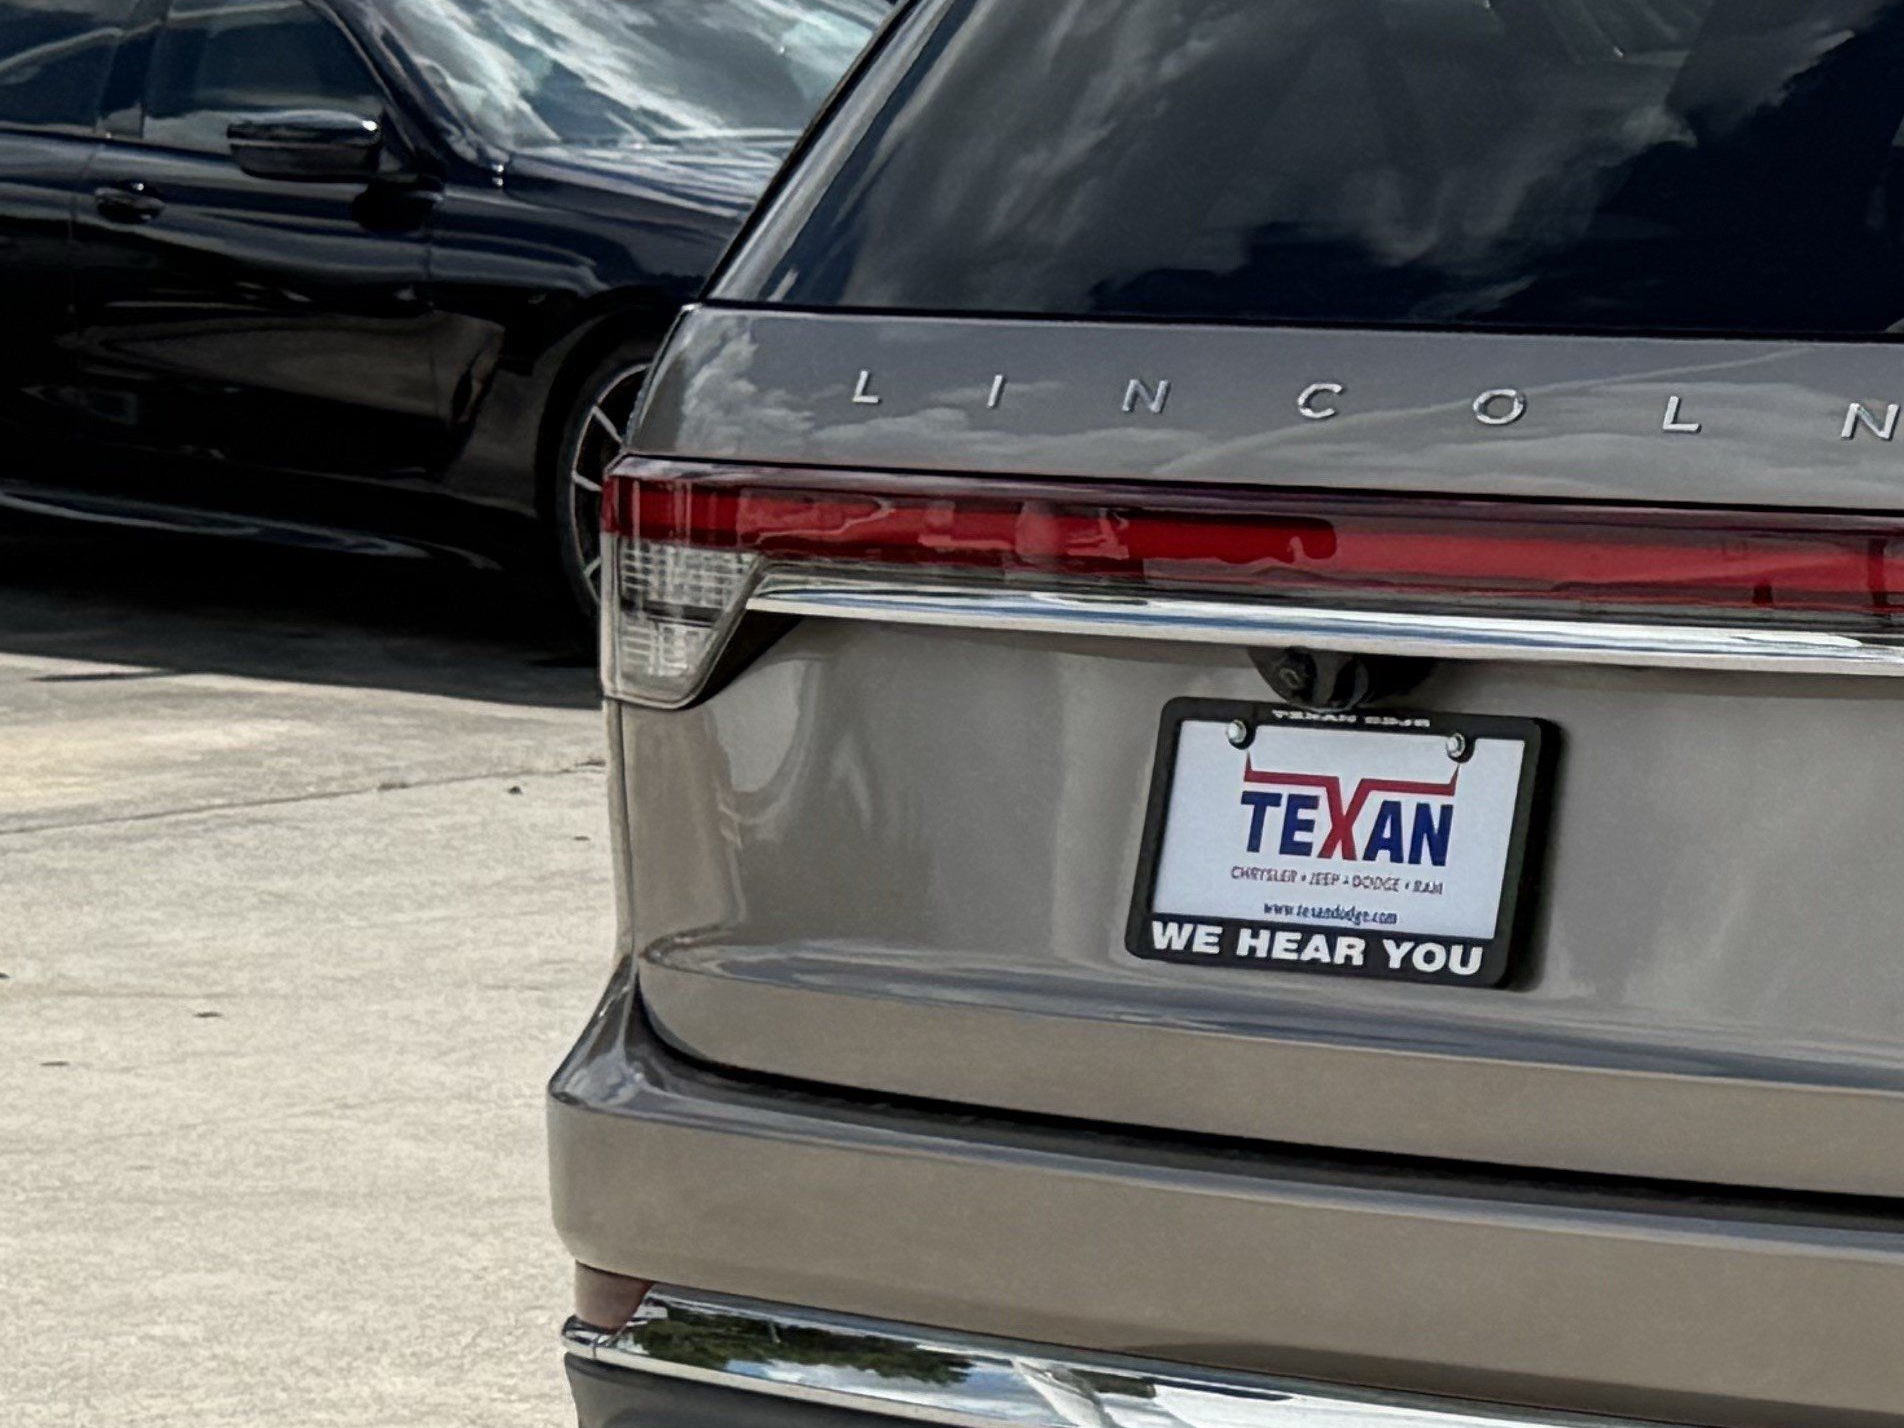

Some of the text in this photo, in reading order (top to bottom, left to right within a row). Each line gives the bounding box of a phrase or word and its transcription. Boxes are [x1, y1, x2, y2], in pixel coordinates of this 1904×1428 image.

[852, 371, 1902, 441] LINCOLN
[1240, 752, 1461, 867] TEXAN
[1231, 865, 1299, 883] CHRYSLER
[1308, 871, 1341, 886] JEEP
[1351, 875, 1401, 893] DODGE
[1151, 920, 1484, 976] WE HEAR YOU
